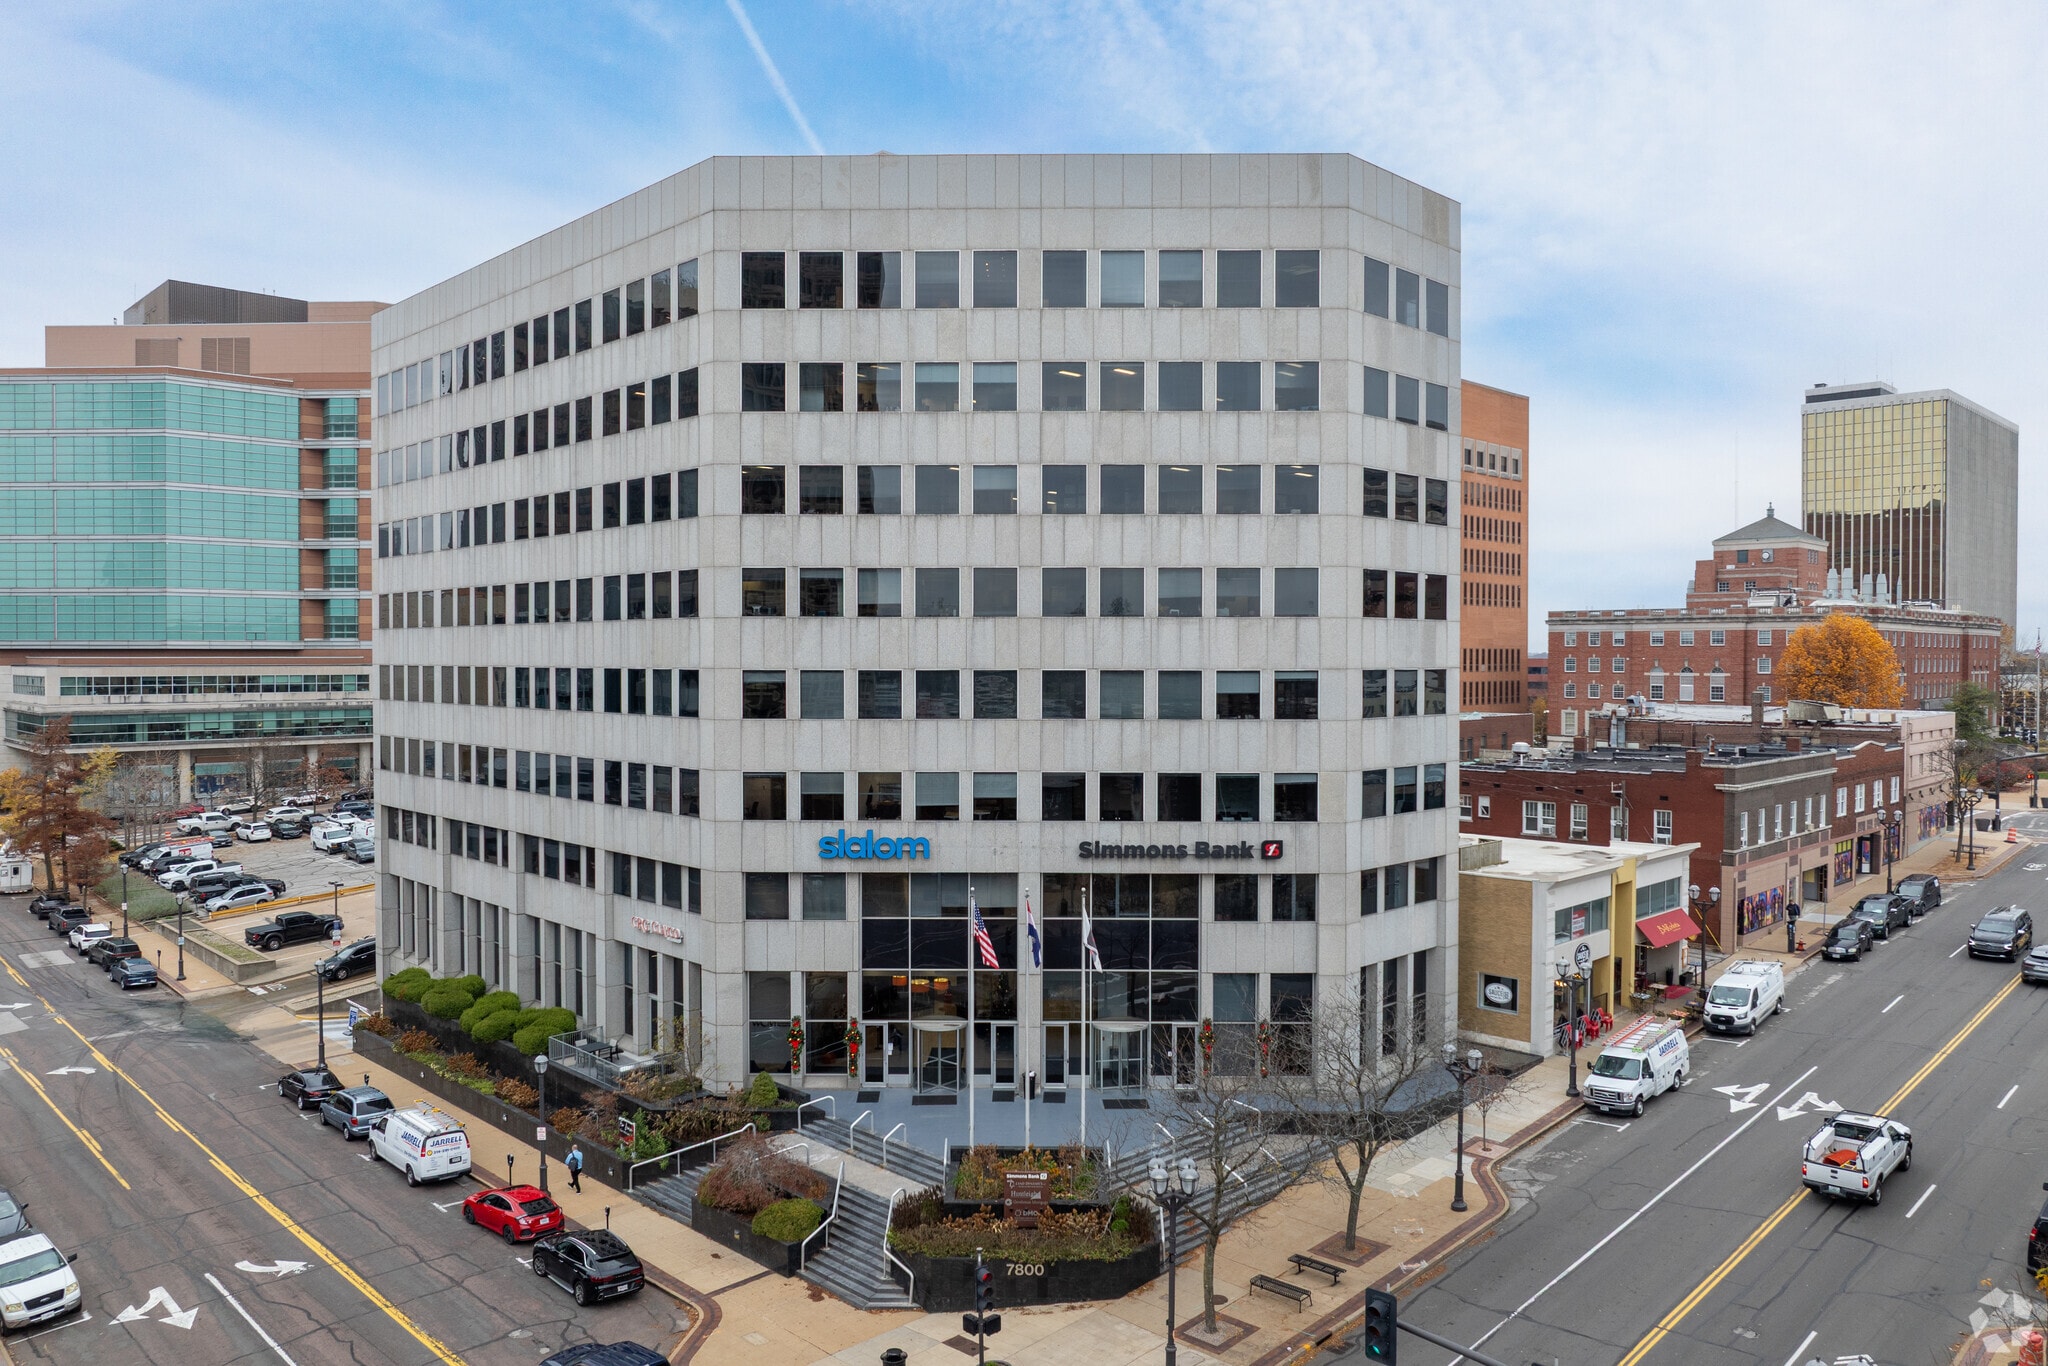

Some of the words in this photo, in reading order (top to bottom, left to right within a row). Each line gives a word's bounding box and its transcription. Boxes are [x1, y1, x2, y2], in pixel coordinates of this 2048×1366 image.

[818, 829, 931, 860] slalom
[1078, 840, 1189, 860] Simmons
[1195, 841, 1255, 859] Bank
[1659, 1037, 1678, 1056] JARRELL
[401, 1131, 421, 1148] JARRELL
[431, 1135, 462, 1147] JARRELL
[1006, 1263, 1045, 1276] 7800
